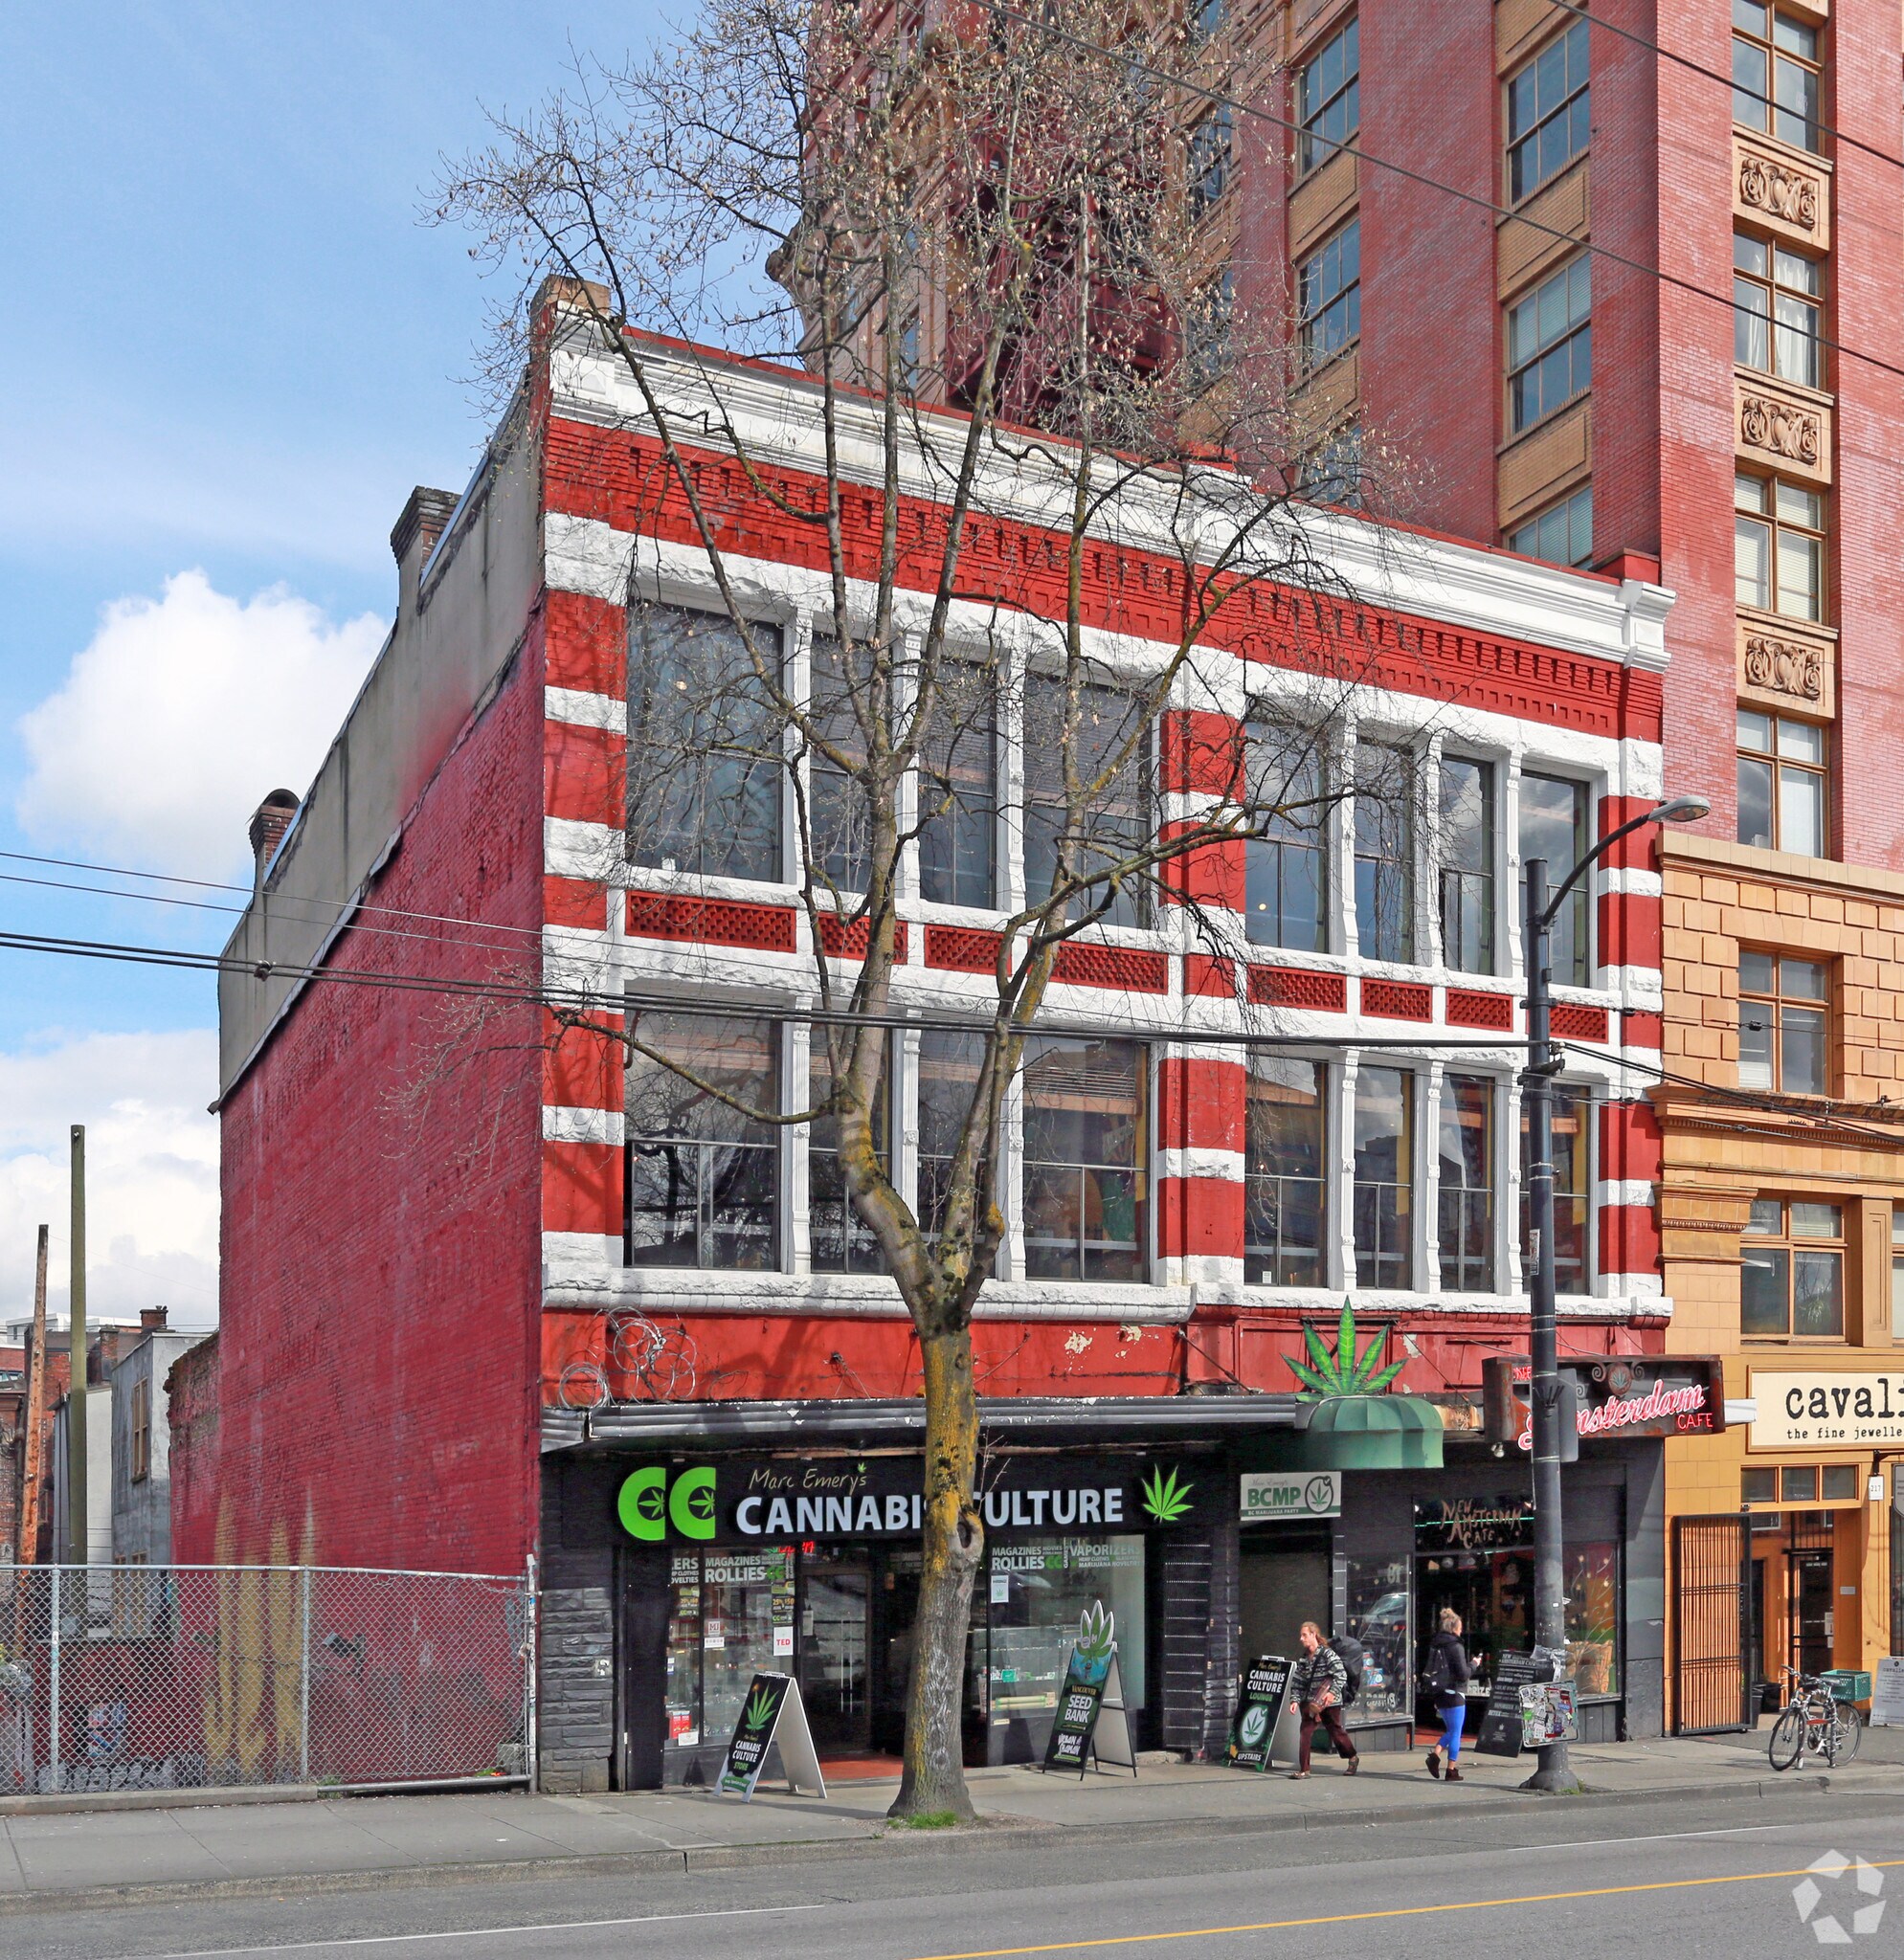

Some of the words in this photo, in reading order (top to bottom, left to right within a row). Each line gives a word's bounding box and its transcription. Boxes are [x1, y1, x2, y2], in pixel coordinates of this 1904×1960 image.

[1677, 1413, 1714, 1430] CAFE
[1787, 1429, 1808, 1439] the
[1818, 1427, 1845, 1438] fine
[749, 1468, 795, 1490] Marc
[1247, 1486, 1302, 1508] BCMP
[735, 1494, 927, 1535] CANNABI
[1440, 1499, 1473, 1530] NEW
[1446, 1507, 1523, 1543] AMSTERDAM
[992, 1546, 1042, 1556] MAGAZINES
[1069, 1544, 1141, 1557] VAPORIZERS
[705, 1555, 761, 1567] MAGAZINES
[991, 1556, 1045, 1570] ROLLIES
[705, 1567, 766, 1583] ROLLIES
[1249, 1669, 1286, 1682] CANNABIS
[1246, 1680, 1283, 1693] CULTURE
[1067, 1694, 1093, 1710] SEED
[1064, 1709, 1090, 1724] BANK
[735, 1741, 761, 1752] CANNABIS
[732, 1750, 758, 1762] CULTURE
